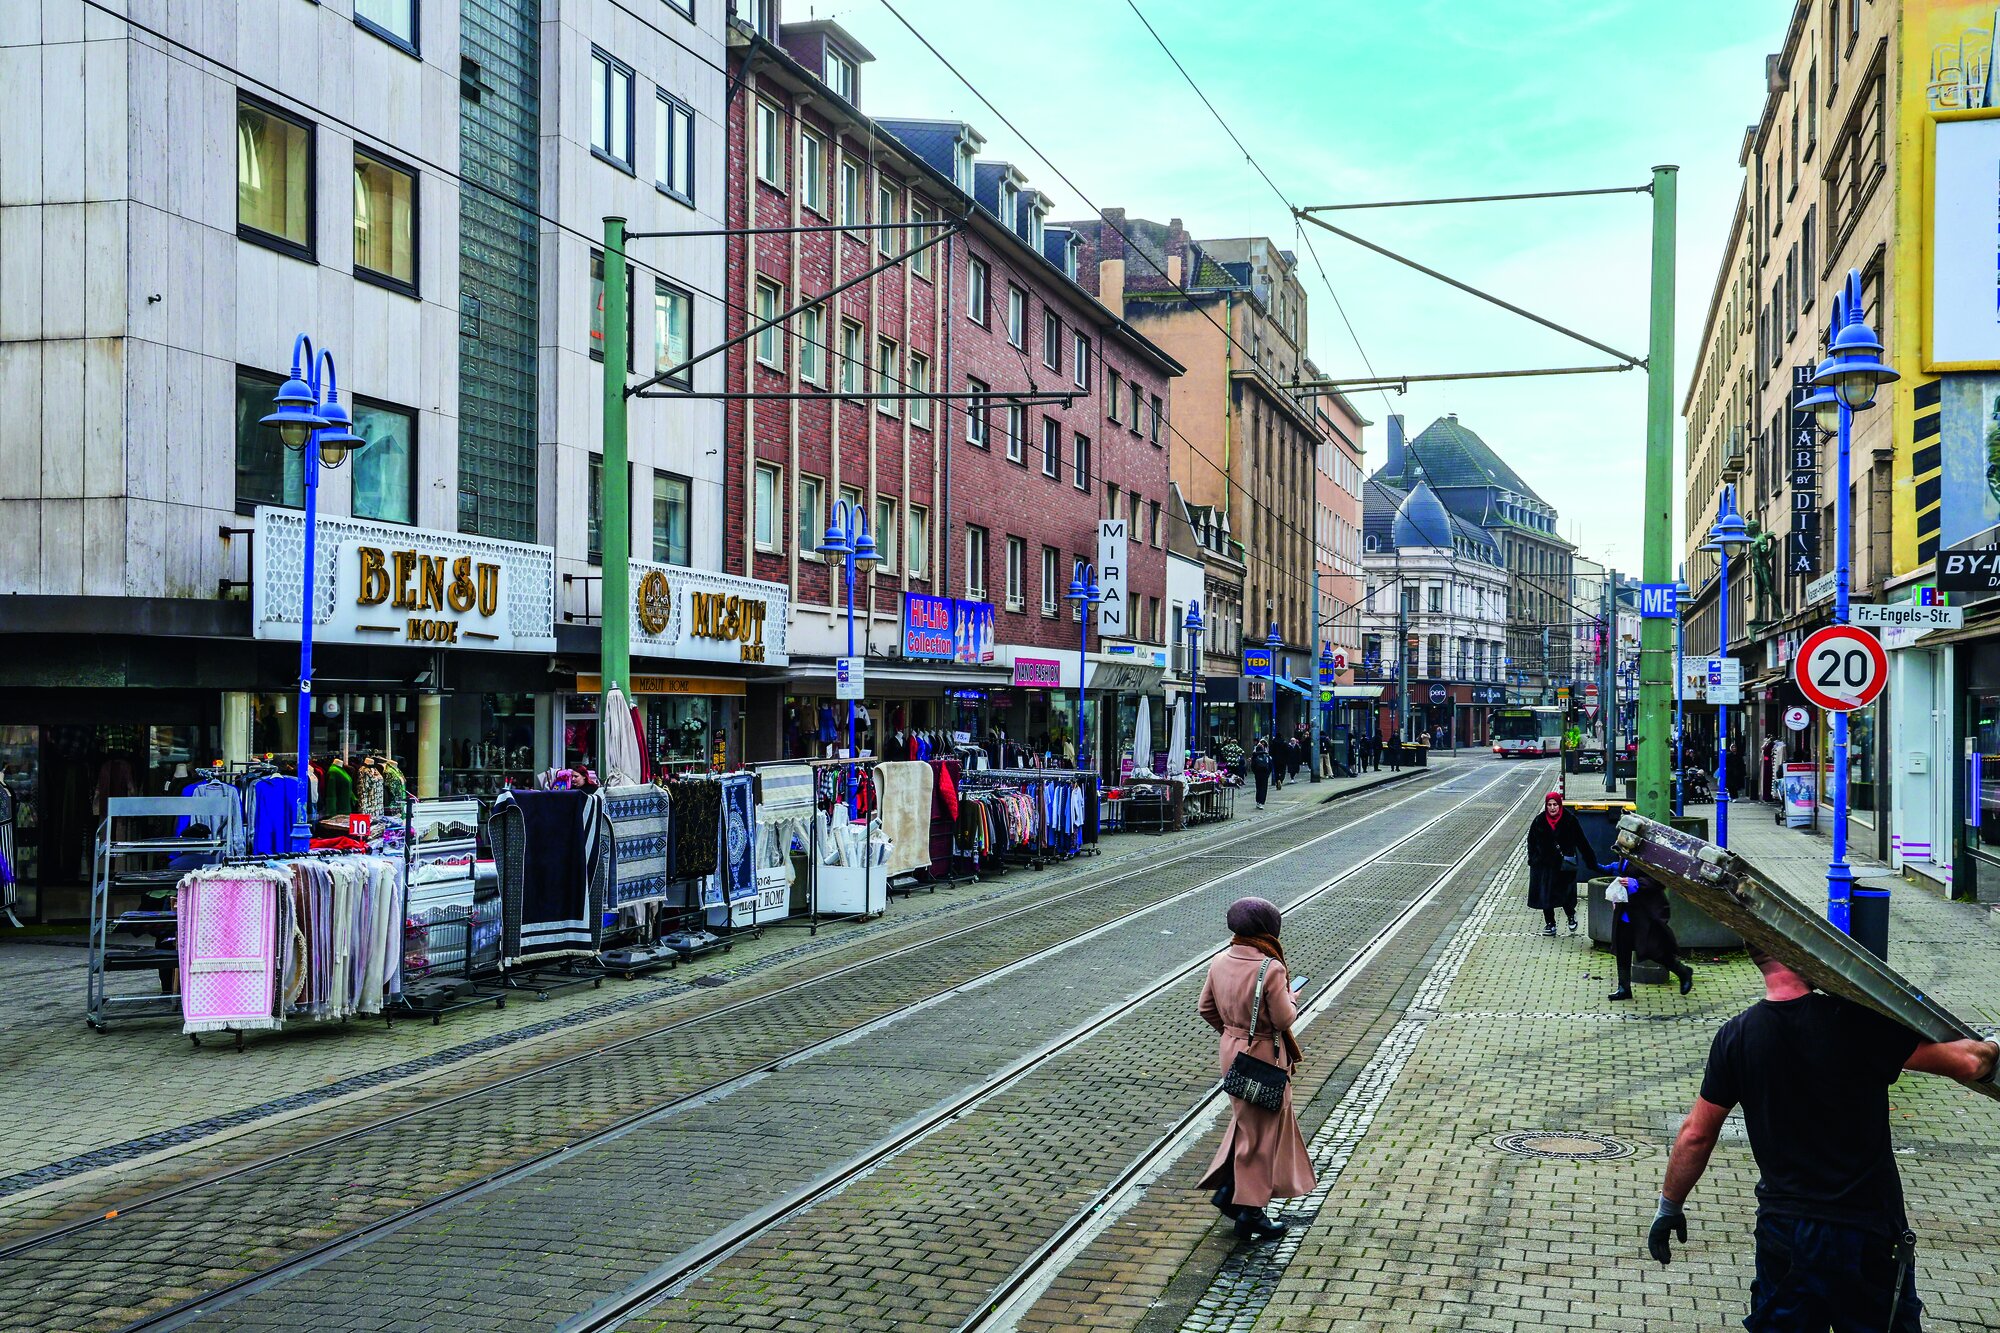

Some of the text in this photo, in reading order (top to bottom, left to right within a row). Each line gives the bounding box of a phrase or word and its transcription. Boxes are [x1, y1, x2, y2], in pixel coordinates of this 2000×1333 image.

[1796, 475, 1811, 484] BY
[357, 546, 501, 617] BENSU
[1103, 523, 1124, 624] MIRAN
[1643, 588, 1673, 613] ME
[691, 591, 766, 646] MESUT
[911, 598, 948, 630] Hi-Life
[1858, 606, 1952, 625] Fr.-Engels-Str.
[407, 618, 458, 643] MODE
[908, 630, 951, 655] Collection
[1016, 662, 1059, 683] NANO FASHION
[1246, 658, 1269, 667] TEDi
[1818, 649, 1868, 687] 20
[639, 678, 689, 691] MESUT HOME
[352, 820, 367, 835] 10
[764, 889, 785, 907] HOME
